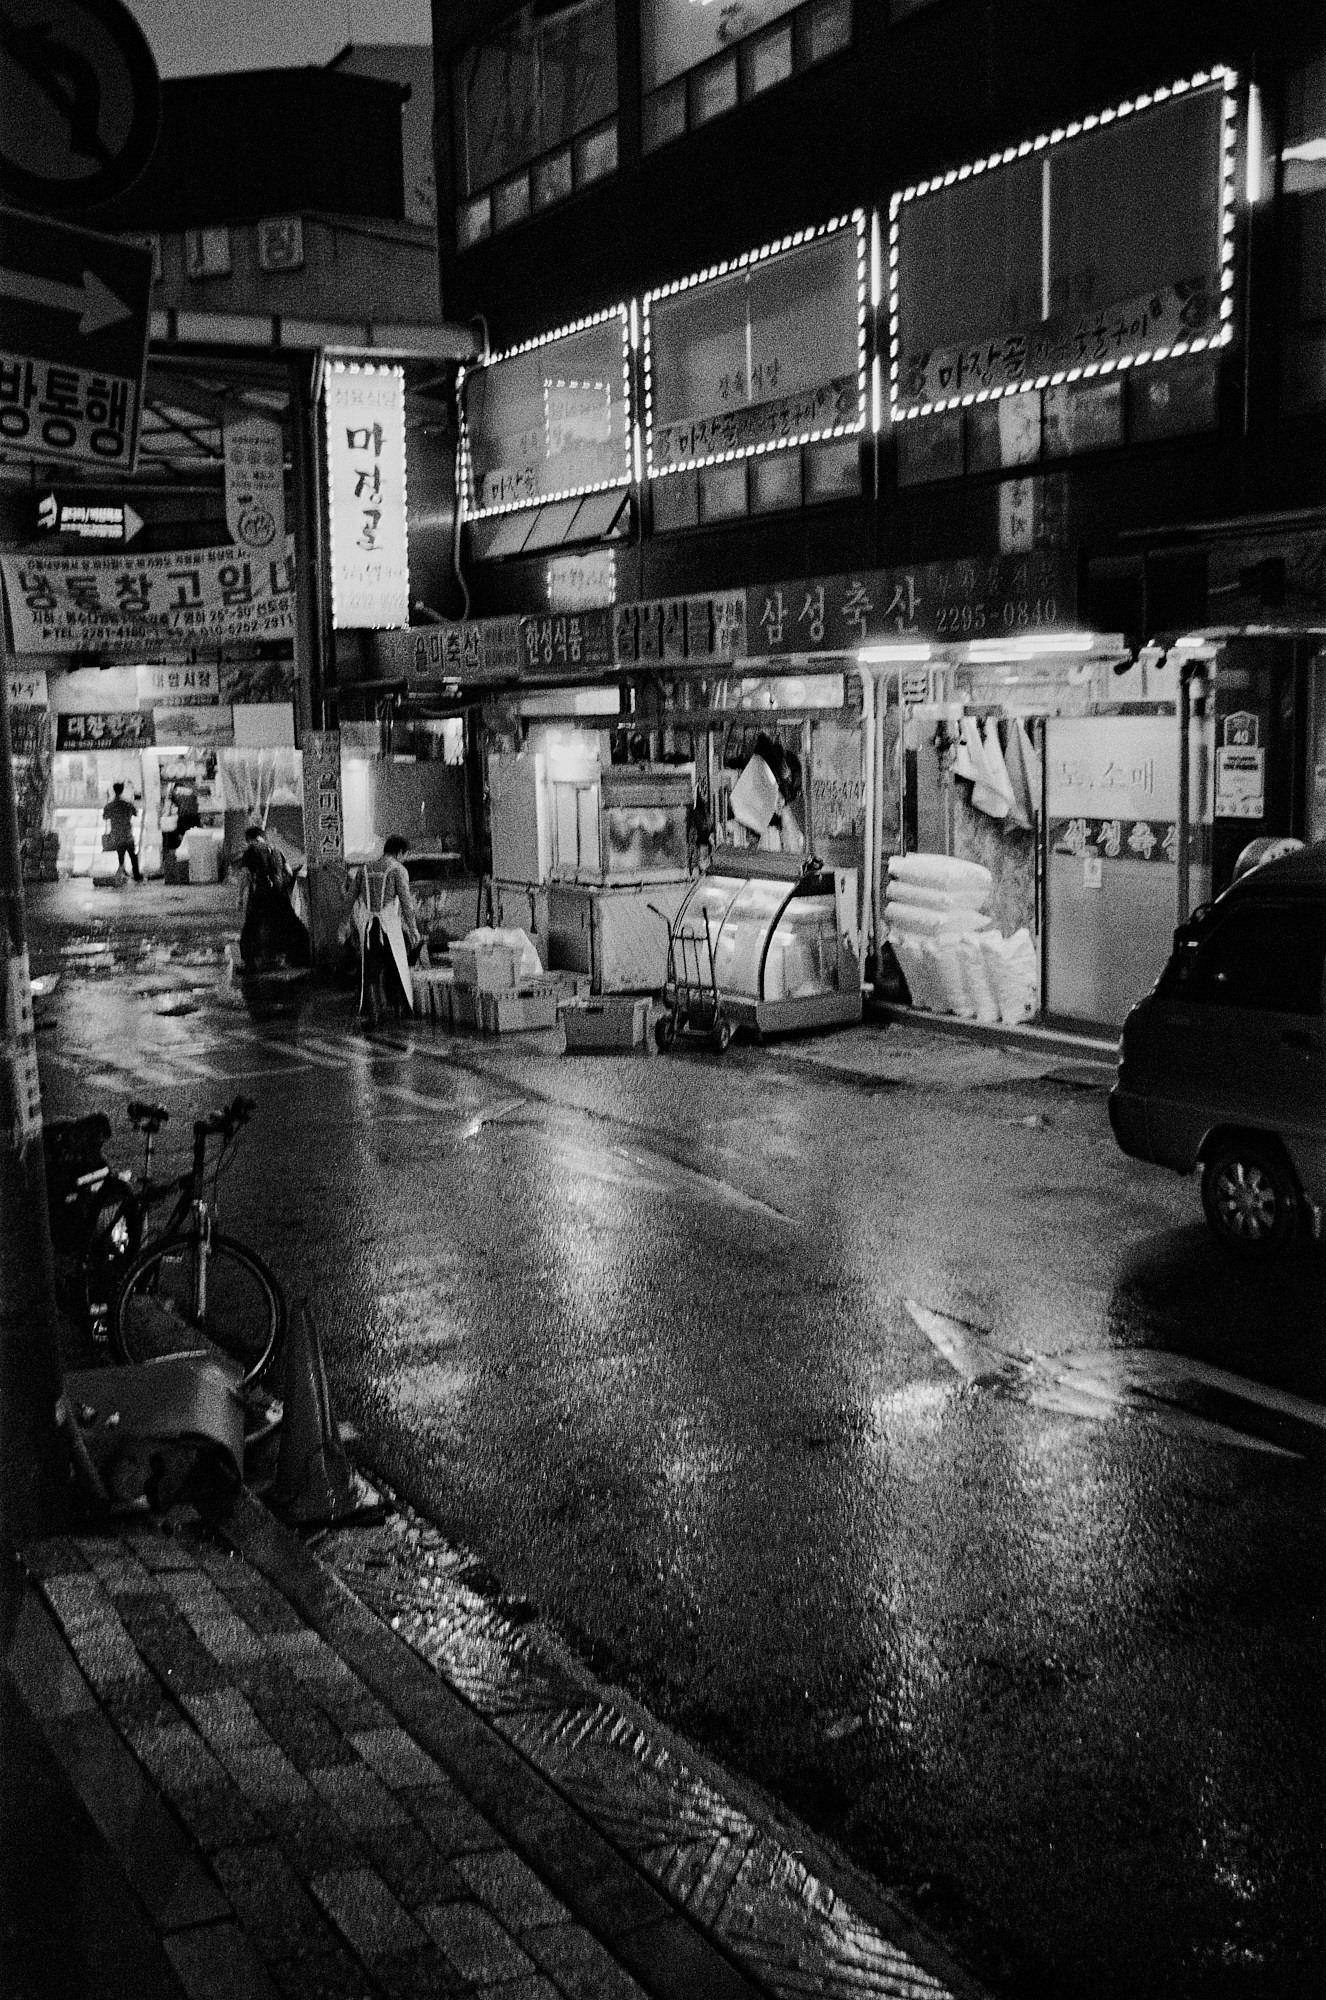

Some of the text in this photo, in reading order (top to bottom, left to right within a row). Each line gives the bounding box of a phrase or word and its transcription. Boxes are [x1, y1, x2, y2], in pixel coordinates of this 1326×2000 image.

[938, 336, 1026, 391] 마장골
[0, 359, 128, 457] 방통행
[678, 411, 740, 456] 마장골
[345, 420, 385, 551] 마장골
[760, 575, 924, 645] 삼성축산
[936, 598, 1057, 633] 2295-0840
[526, 617, 583, 666] 한성식품
